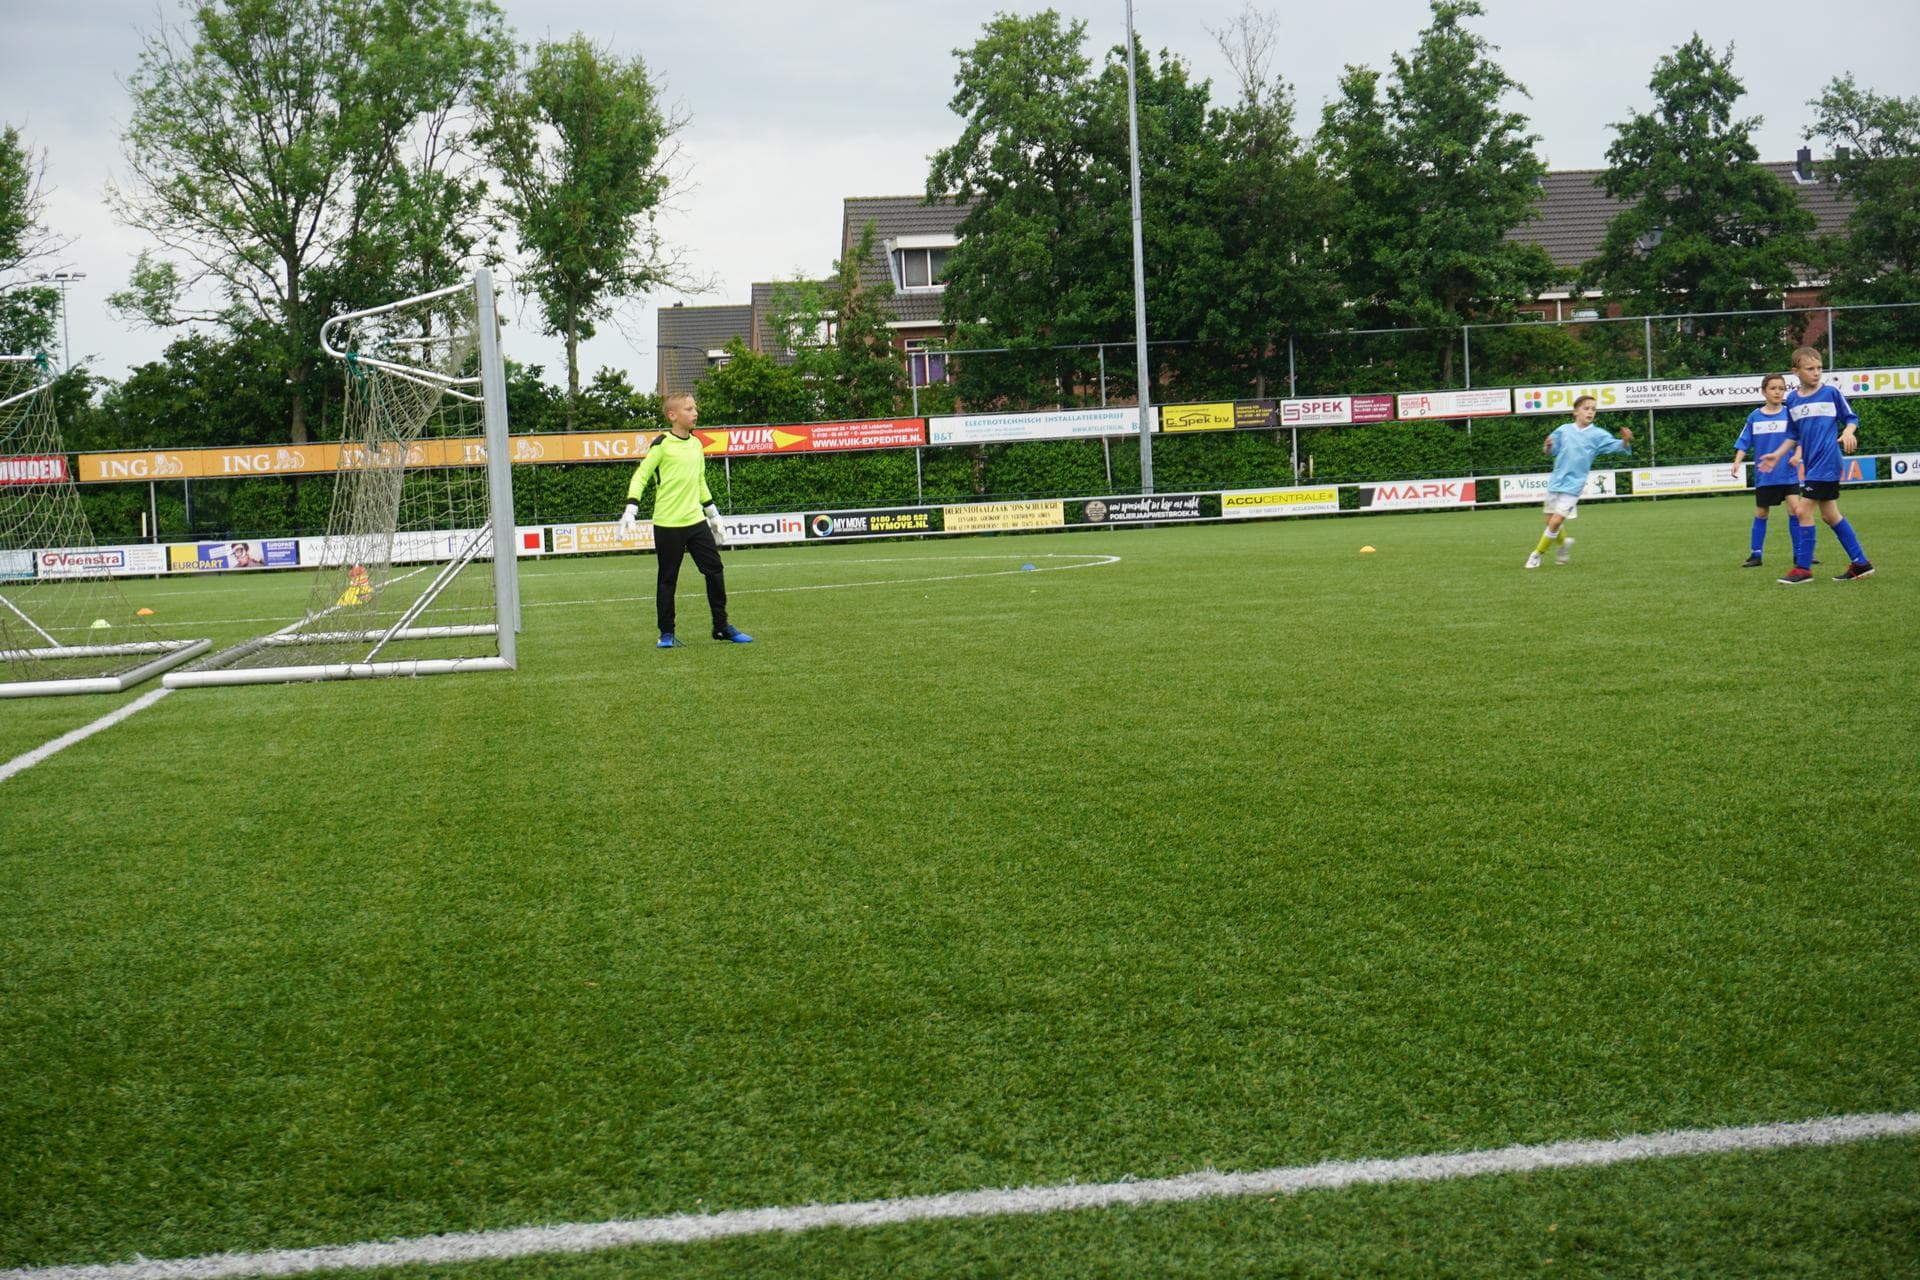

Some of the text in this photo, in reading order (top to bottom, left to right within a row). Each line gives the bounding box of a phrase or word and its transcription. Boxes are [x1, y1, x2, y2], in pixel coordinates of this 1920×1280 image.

[1625, 383, 1692, 393] PLUS VERGEER
[1301, 401, 1343, 414] SPEK
[729, 429, 775, 445] VUIK
[812, 434, 923, 448] WWW.VUIK-EXPEDITIE.NL
[933, 432, 954, 442] B&T
[464, 445, 489, 463] IN
[582, 440, 629, 457] ING
[100, 459, 149, 478] ING
[222, 454, 272, 473] ING
[1226, 491, 1328, 506] ACCUCENTRALE
[1377, 483, 1457, 501] MARK
[870, 521, 929, 532] MYMOVE.NL
[172, 559, 224, 570] EUROPART
